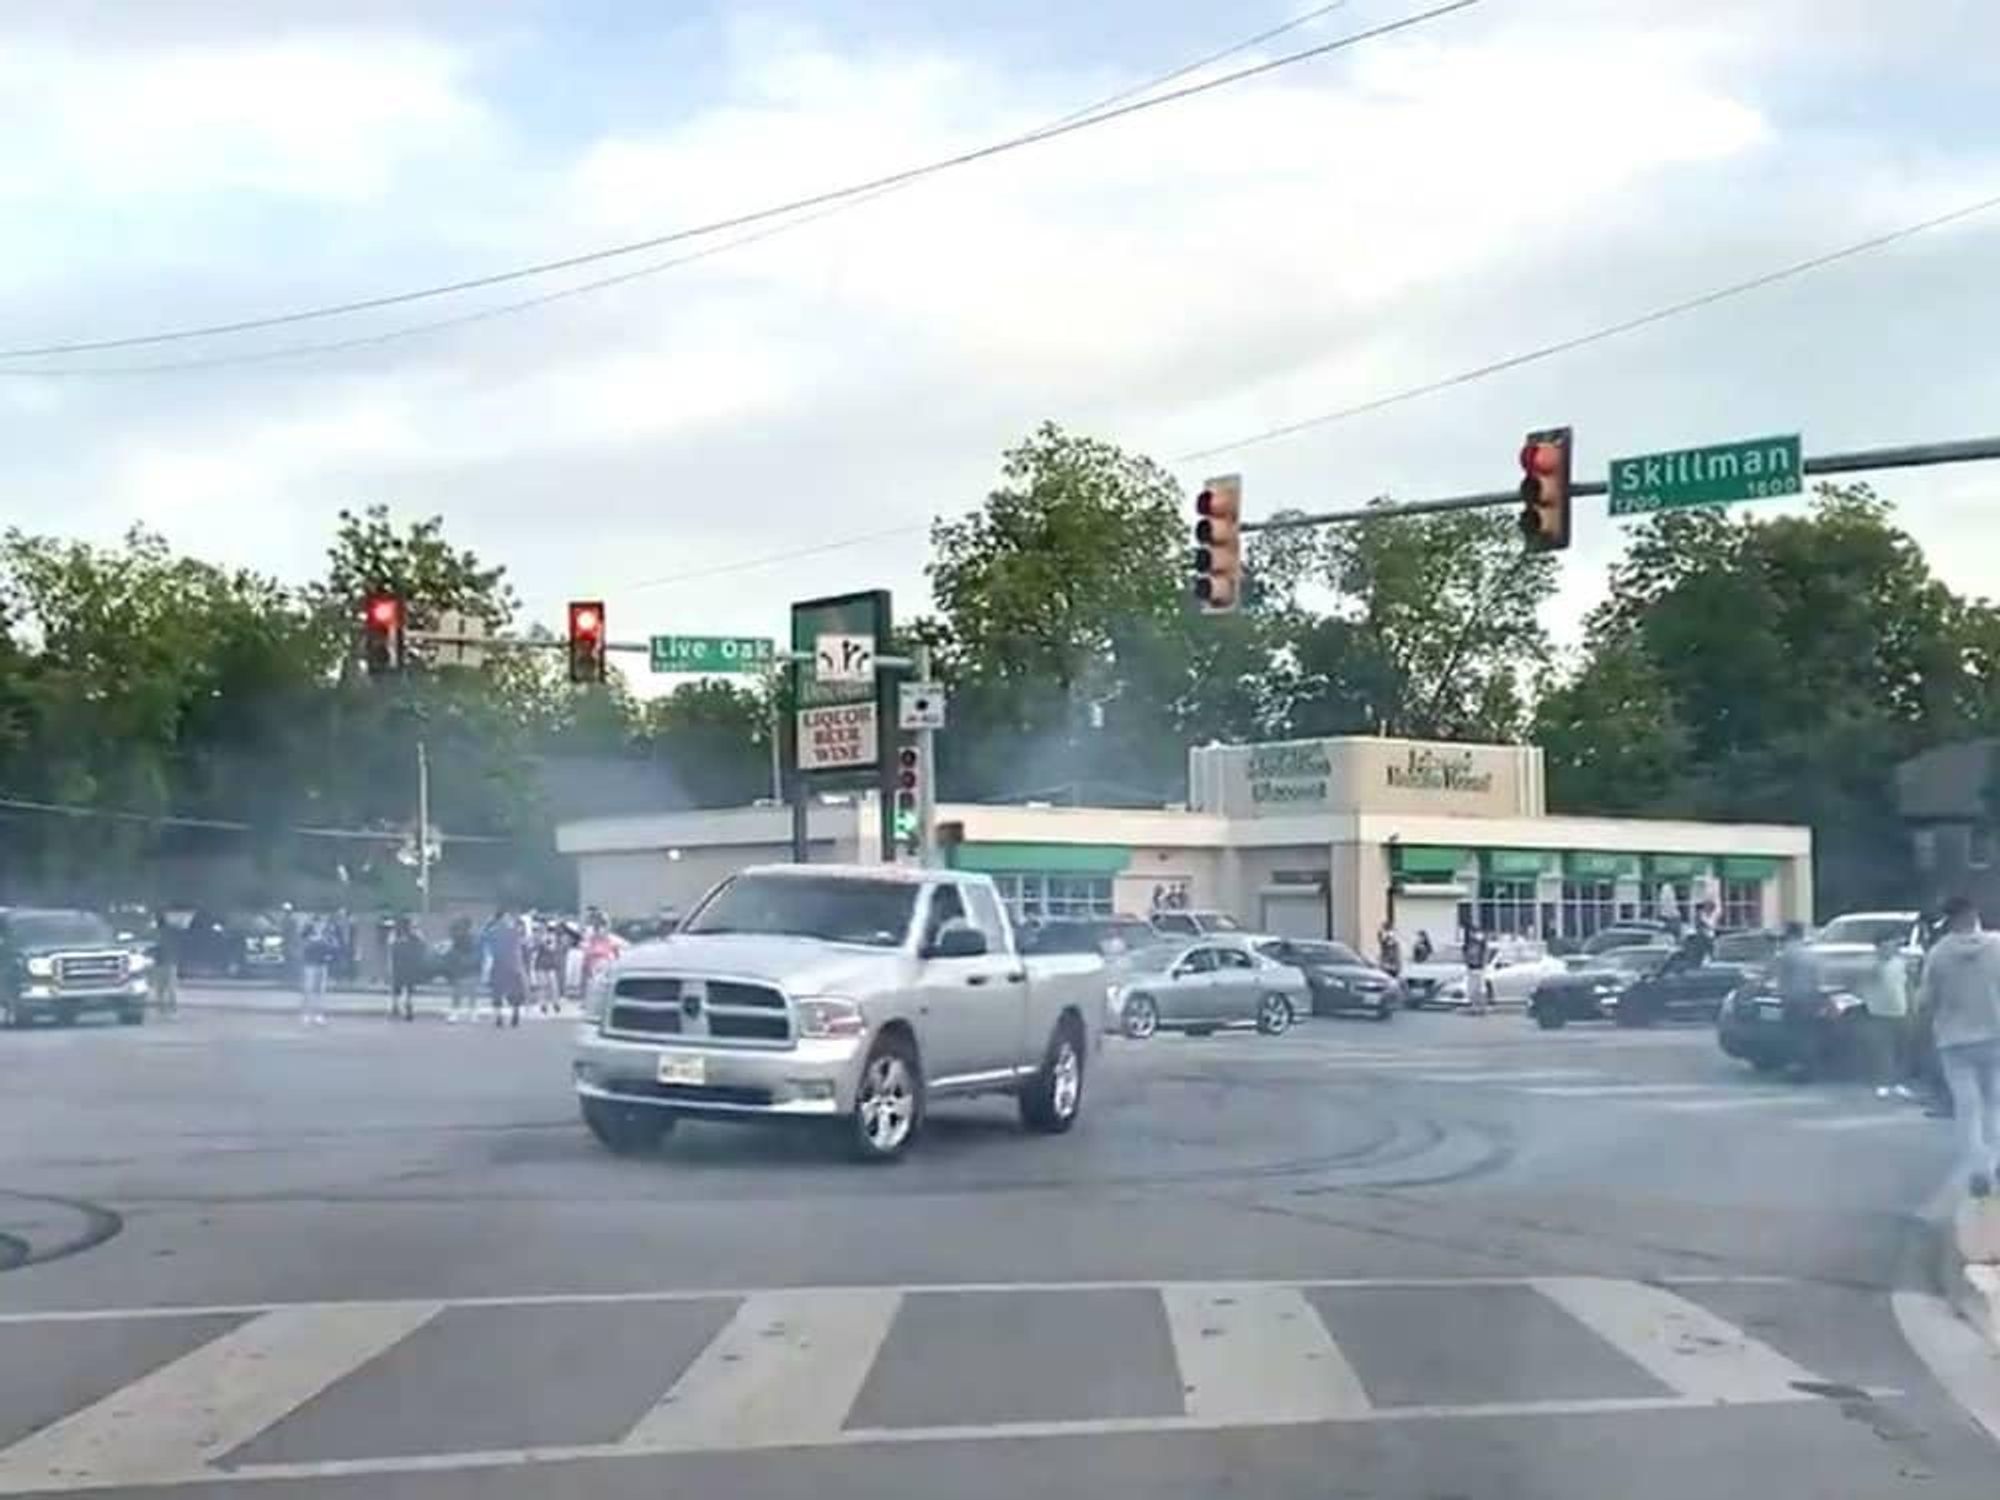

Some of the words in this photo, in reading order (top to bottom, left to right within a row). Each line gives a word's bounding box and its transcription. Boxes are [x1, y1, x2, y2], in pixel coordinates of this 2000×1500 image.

[1621, 447, 1789, 491] Skillman
[656, 637, 707, 659] Live
[720, 639, 770, 659] Oak
[803, 706, 872, 728] LIQUOR
[814, 728, 860, 745] BEER
[813, 745, 861, 762] WINE
